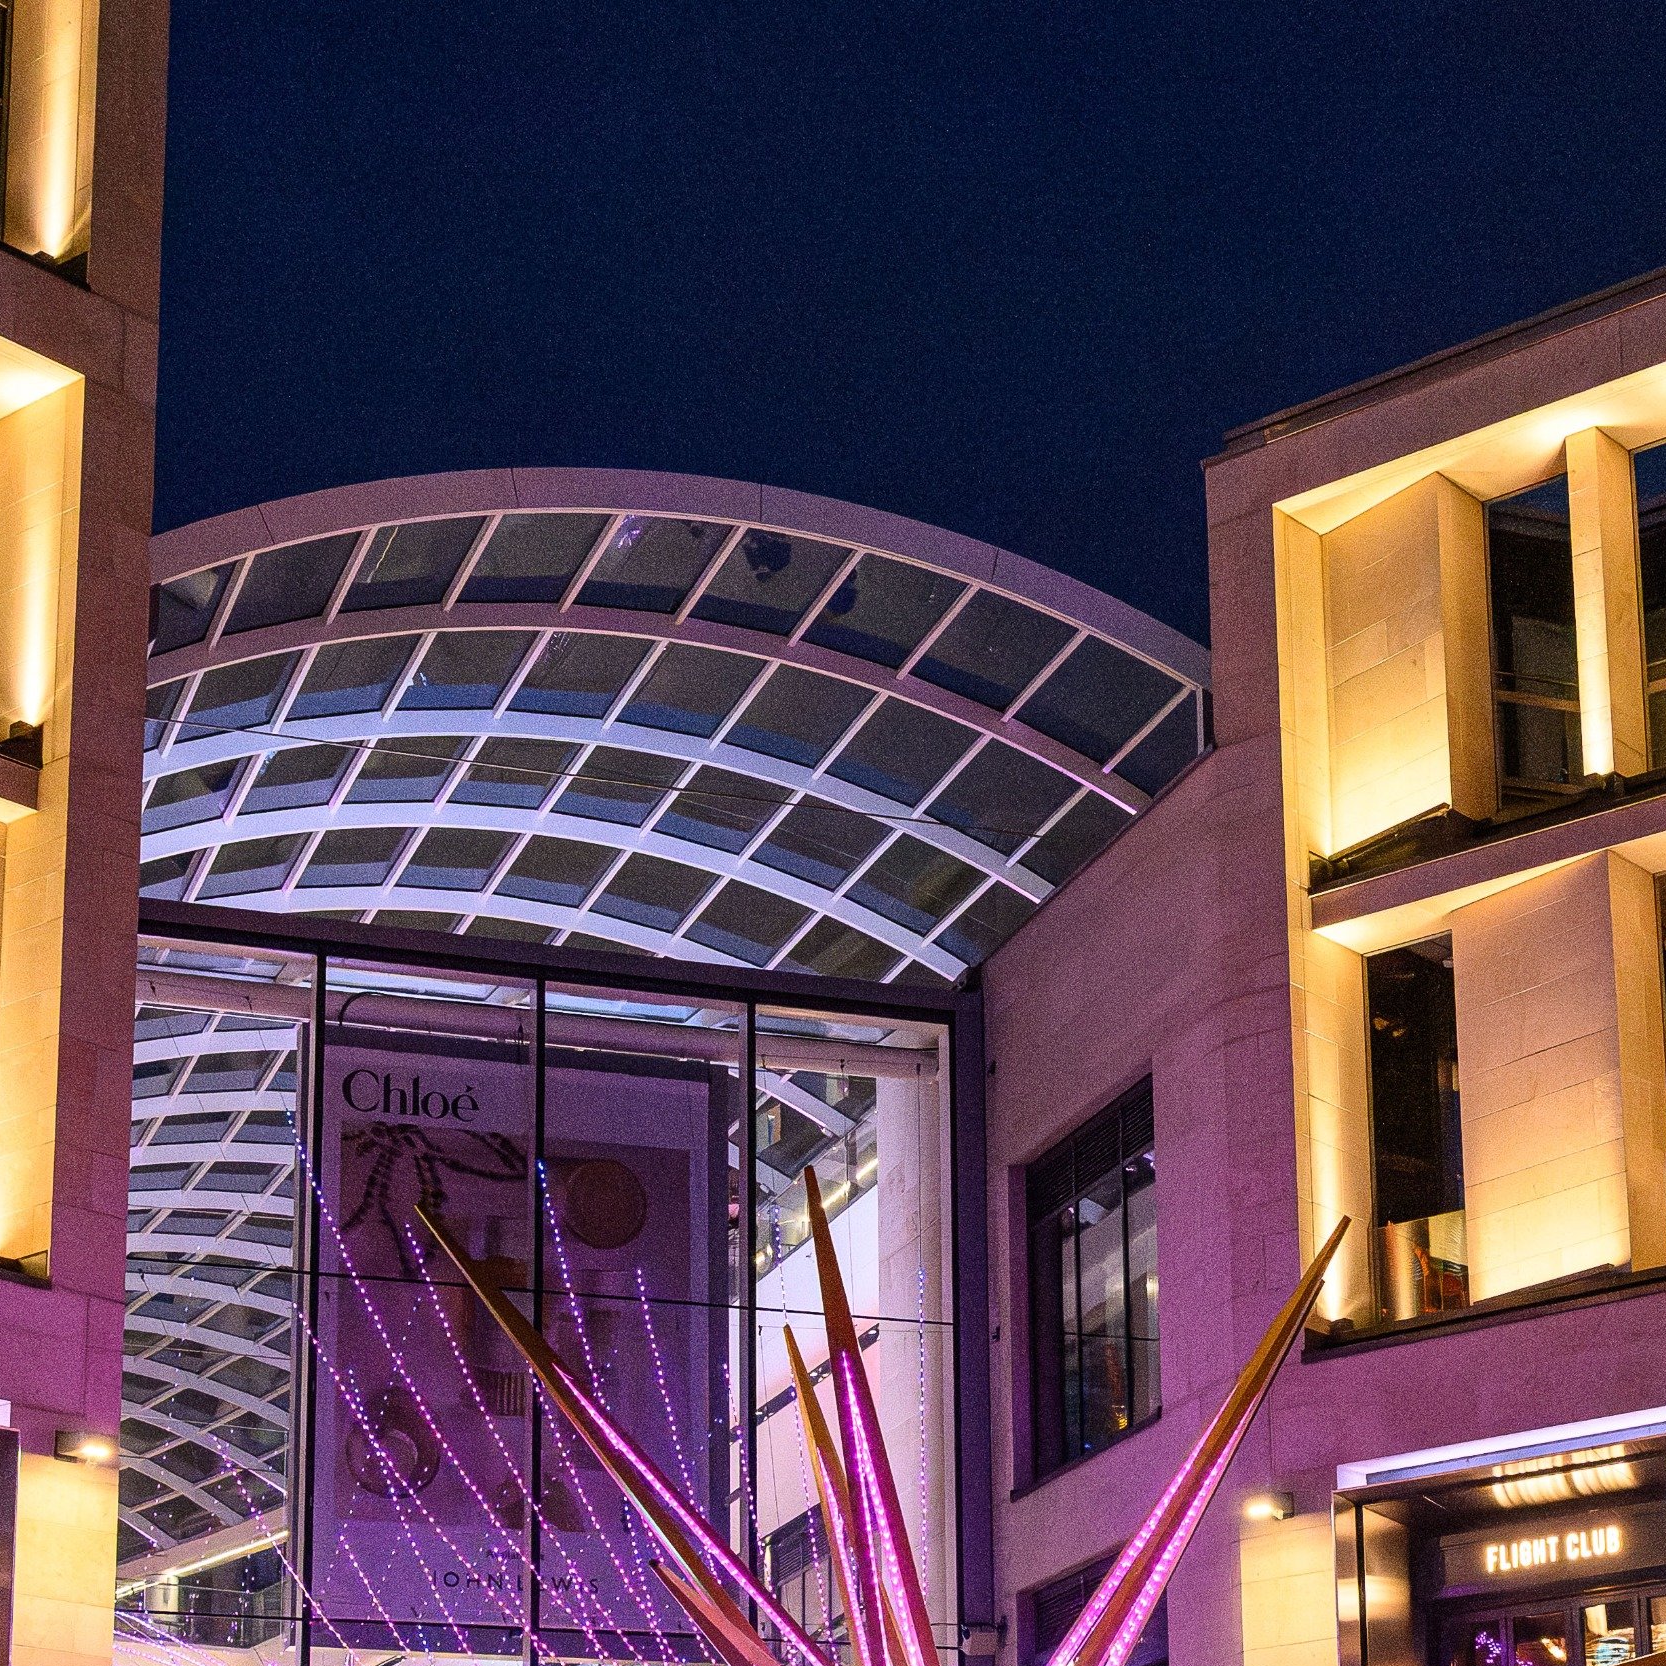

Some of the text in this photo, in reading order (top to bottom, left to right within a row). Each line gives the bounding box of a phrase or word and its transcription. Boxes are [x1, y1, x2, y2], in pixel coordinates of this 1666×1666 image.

[342, 1069, 480, 1122] Chloé
[1486, 1525, 1621, 1573] FLIGHT CLUB
[517, 1575, 599, 1594] LWIS
